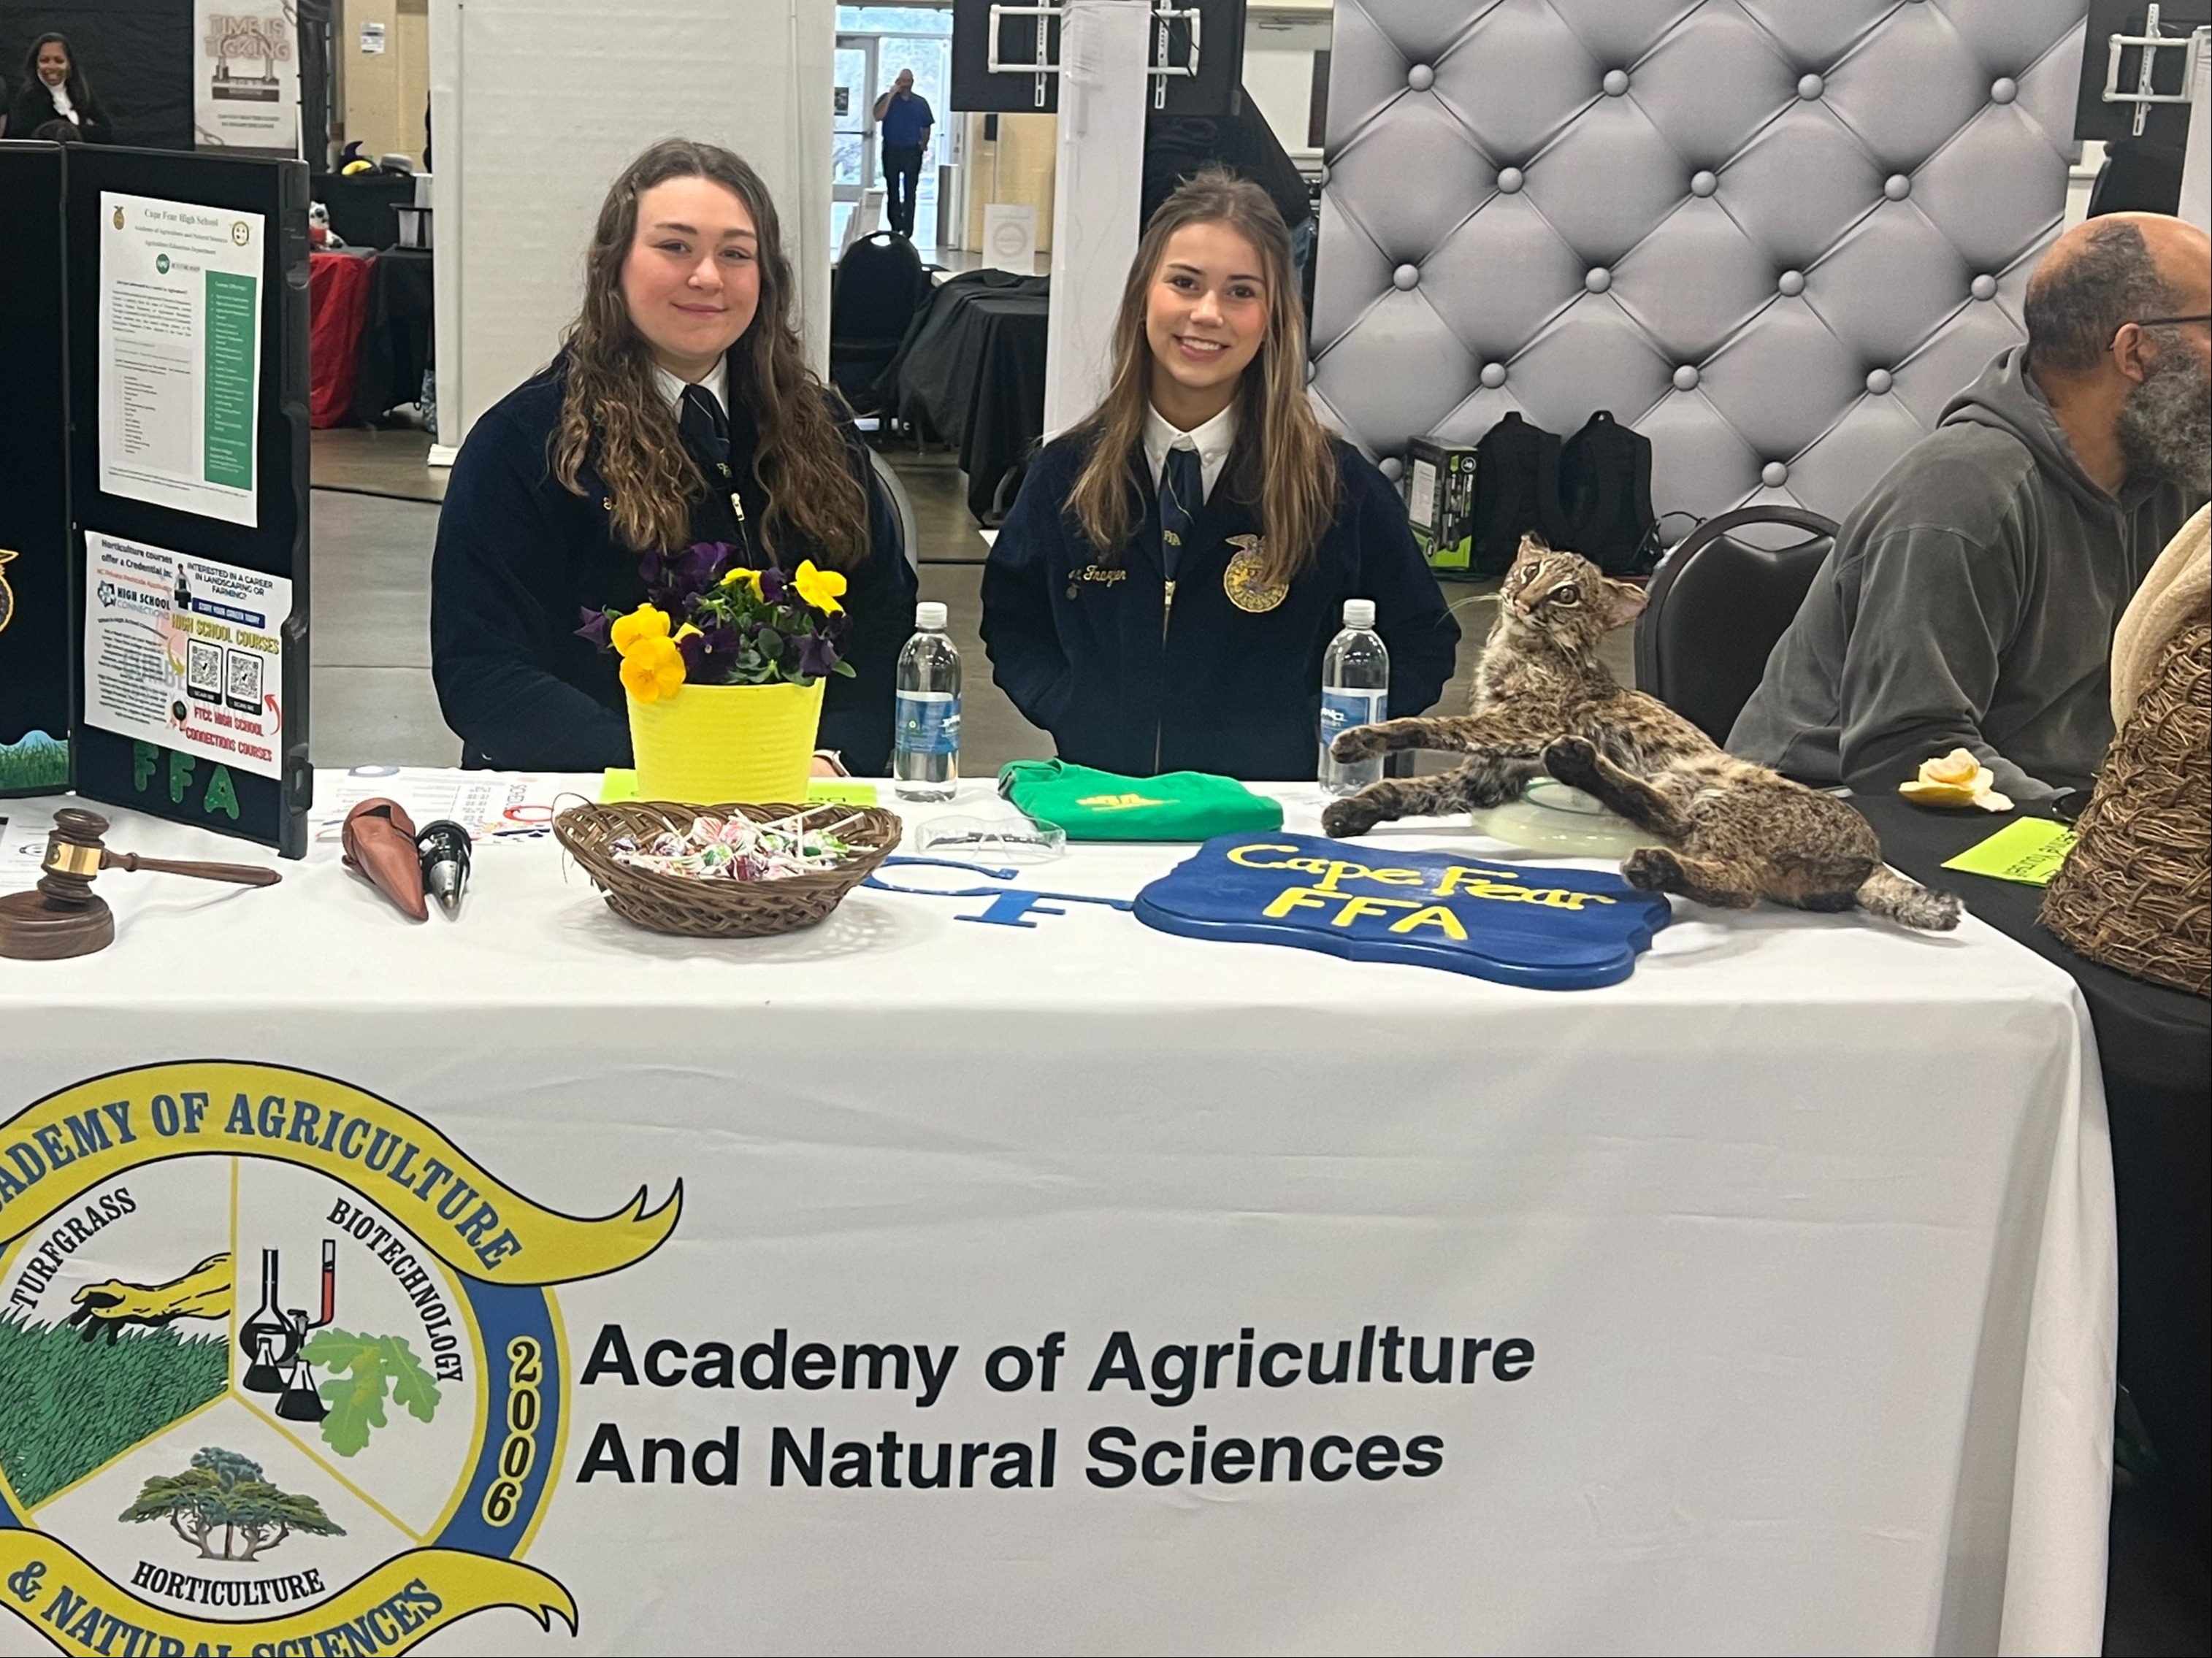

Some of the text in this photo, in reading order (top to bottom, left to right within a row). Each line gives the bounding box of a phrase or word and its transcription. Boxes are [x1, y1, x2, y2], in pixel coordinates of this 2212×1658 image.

[208, 14, 286, 37] TIME IS
[179, 213, 196, 225] High
[196, 215, 218, 226] School
[101, 539, 172, 564] Horticulture courses
[101, 552, 118, 564] offer
[126, 559, 161, 575] Credential
[187, 561, 228, 578] INTERESTED
[229, 572, 237, 580] IN
[244, 575, 273, 589] CAREER
[194, 572, 264, 596] IN LANDSCAPING OR
[117, 587, 170, 610] HIGH SCHOOL
[117, 599, 169, 621] CONNECTIONS
[172, 613, 280, 656] HIGH SCHOOL COURSES
[185, 726, 272, 762] CONNECTIONS COURSES
[214, 711, 232, 728] HIGH
[234, 717, 264, 737] SCHOOL
[134, 741, 240, 820] FFA
[1226, 844, 1616, 911] Cape Fear
[1263, 887, 1469, 941] FFA
[150, 1091, 210, 1137] OF
[224, 1094, 523, 1271] AGRICULTURE
[9, 1187, 137, 1310] TURFGRASS
[326, 1197, 464, 1382] BIOTECHNOLOGY
[580, 1324, 1534, 1407] Academy of Agriculture
[484, 1339, 540, 1524] 2006
[576, 1424, 1443, 1488] And Natural Sciences
[7, 1561, 47, 1603] &
[131, 1560, 326, 1607] HORTICULTURE
